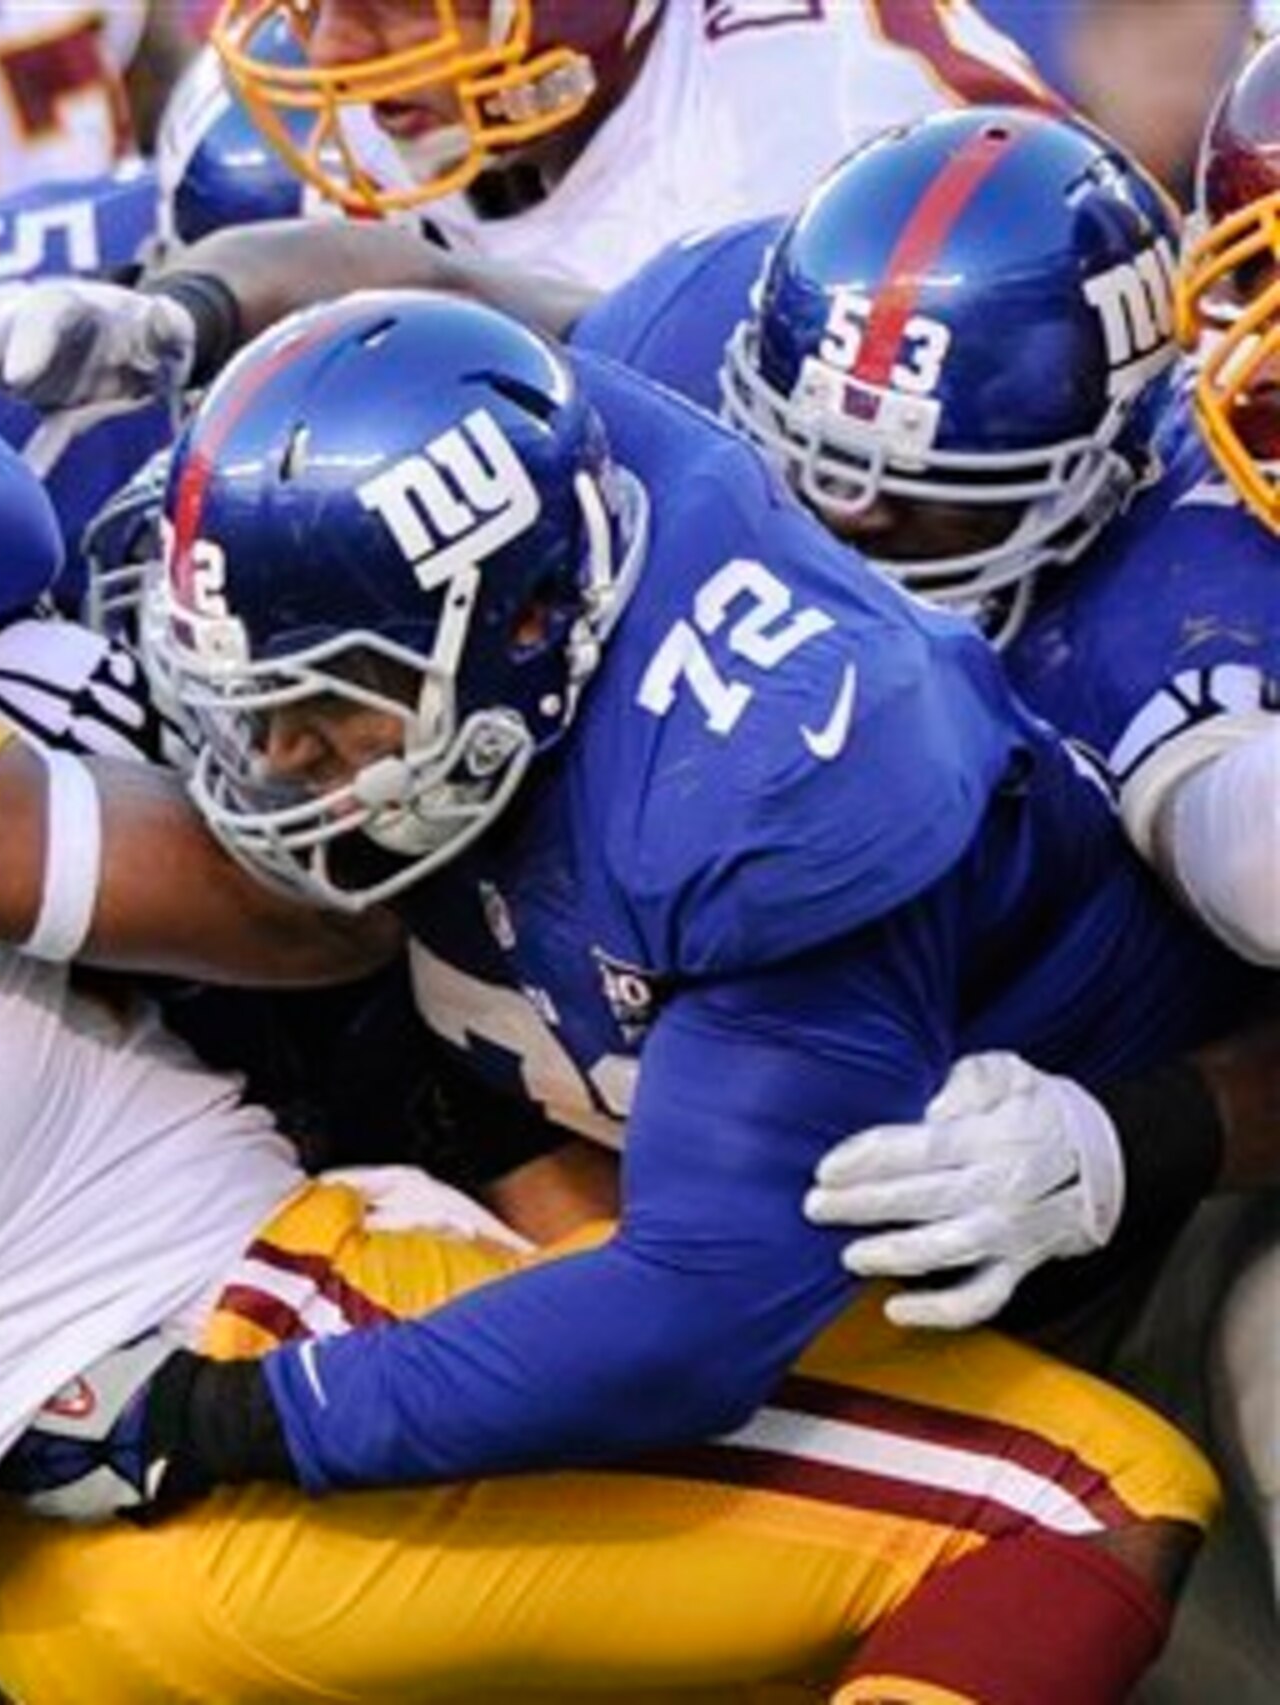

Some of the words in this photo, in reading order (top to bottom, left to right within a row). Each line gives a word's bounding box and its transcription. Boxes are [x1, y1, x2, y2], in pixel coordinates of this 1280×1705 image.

[820, 283, 952, 393] 53
[354, 407, 542, 592] ny
[636, 557, 837, 736] 72
